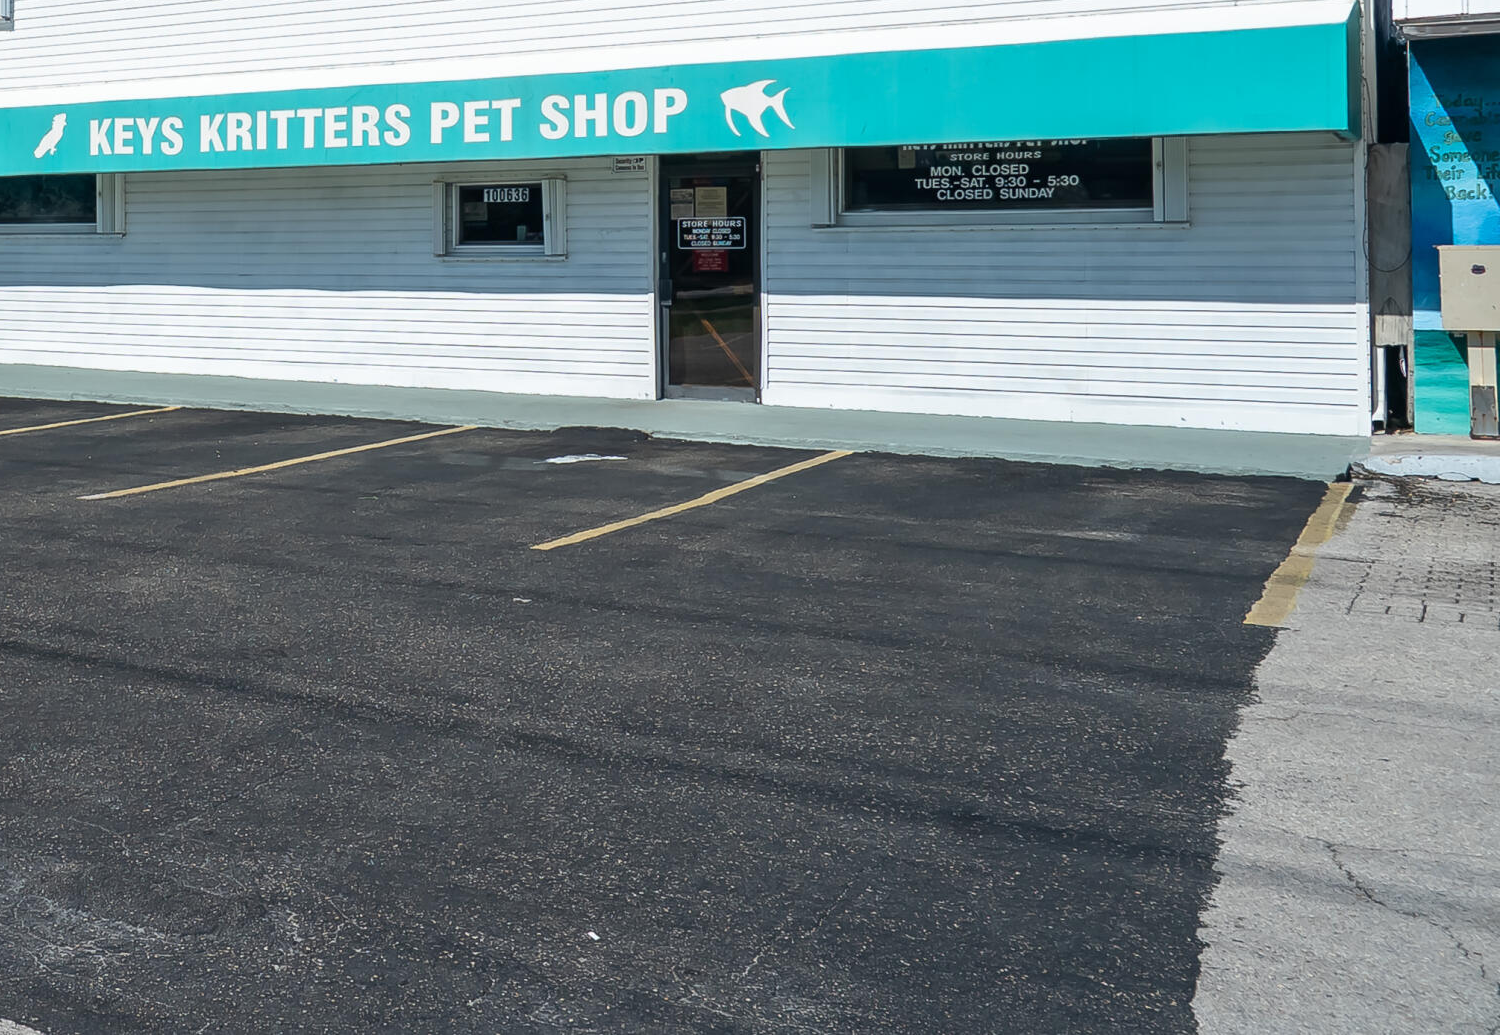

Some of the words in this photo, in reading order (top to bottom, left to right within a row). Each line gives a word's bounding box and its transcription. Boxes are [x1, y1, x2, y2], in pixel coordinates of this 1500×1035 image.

[89, 116, 183, 156] KEYS
[200, 103, 411, 153] KRITTERS
[430, 98, 521, 144] PET
[539, 88, 688, 140] SHOP
[950, 153, 990, 161] STORE
[997, 151, 1042, 160] HOURS
[930, 166, 965, 177] MON.
[971, 164, 1029, 176] CLOSED
[1424, 165, 1466, 181] Their
[995, 176, 1026, 187] 9:30
[1047, 175, 1079, 187] 5:30
[485, 188, 528, 202] 100636
[937, 189, 993, 200] CLOSED
[1000, 188, 1055, 199] SUNDAY
[1445, 184, 1493, 200] Back!
